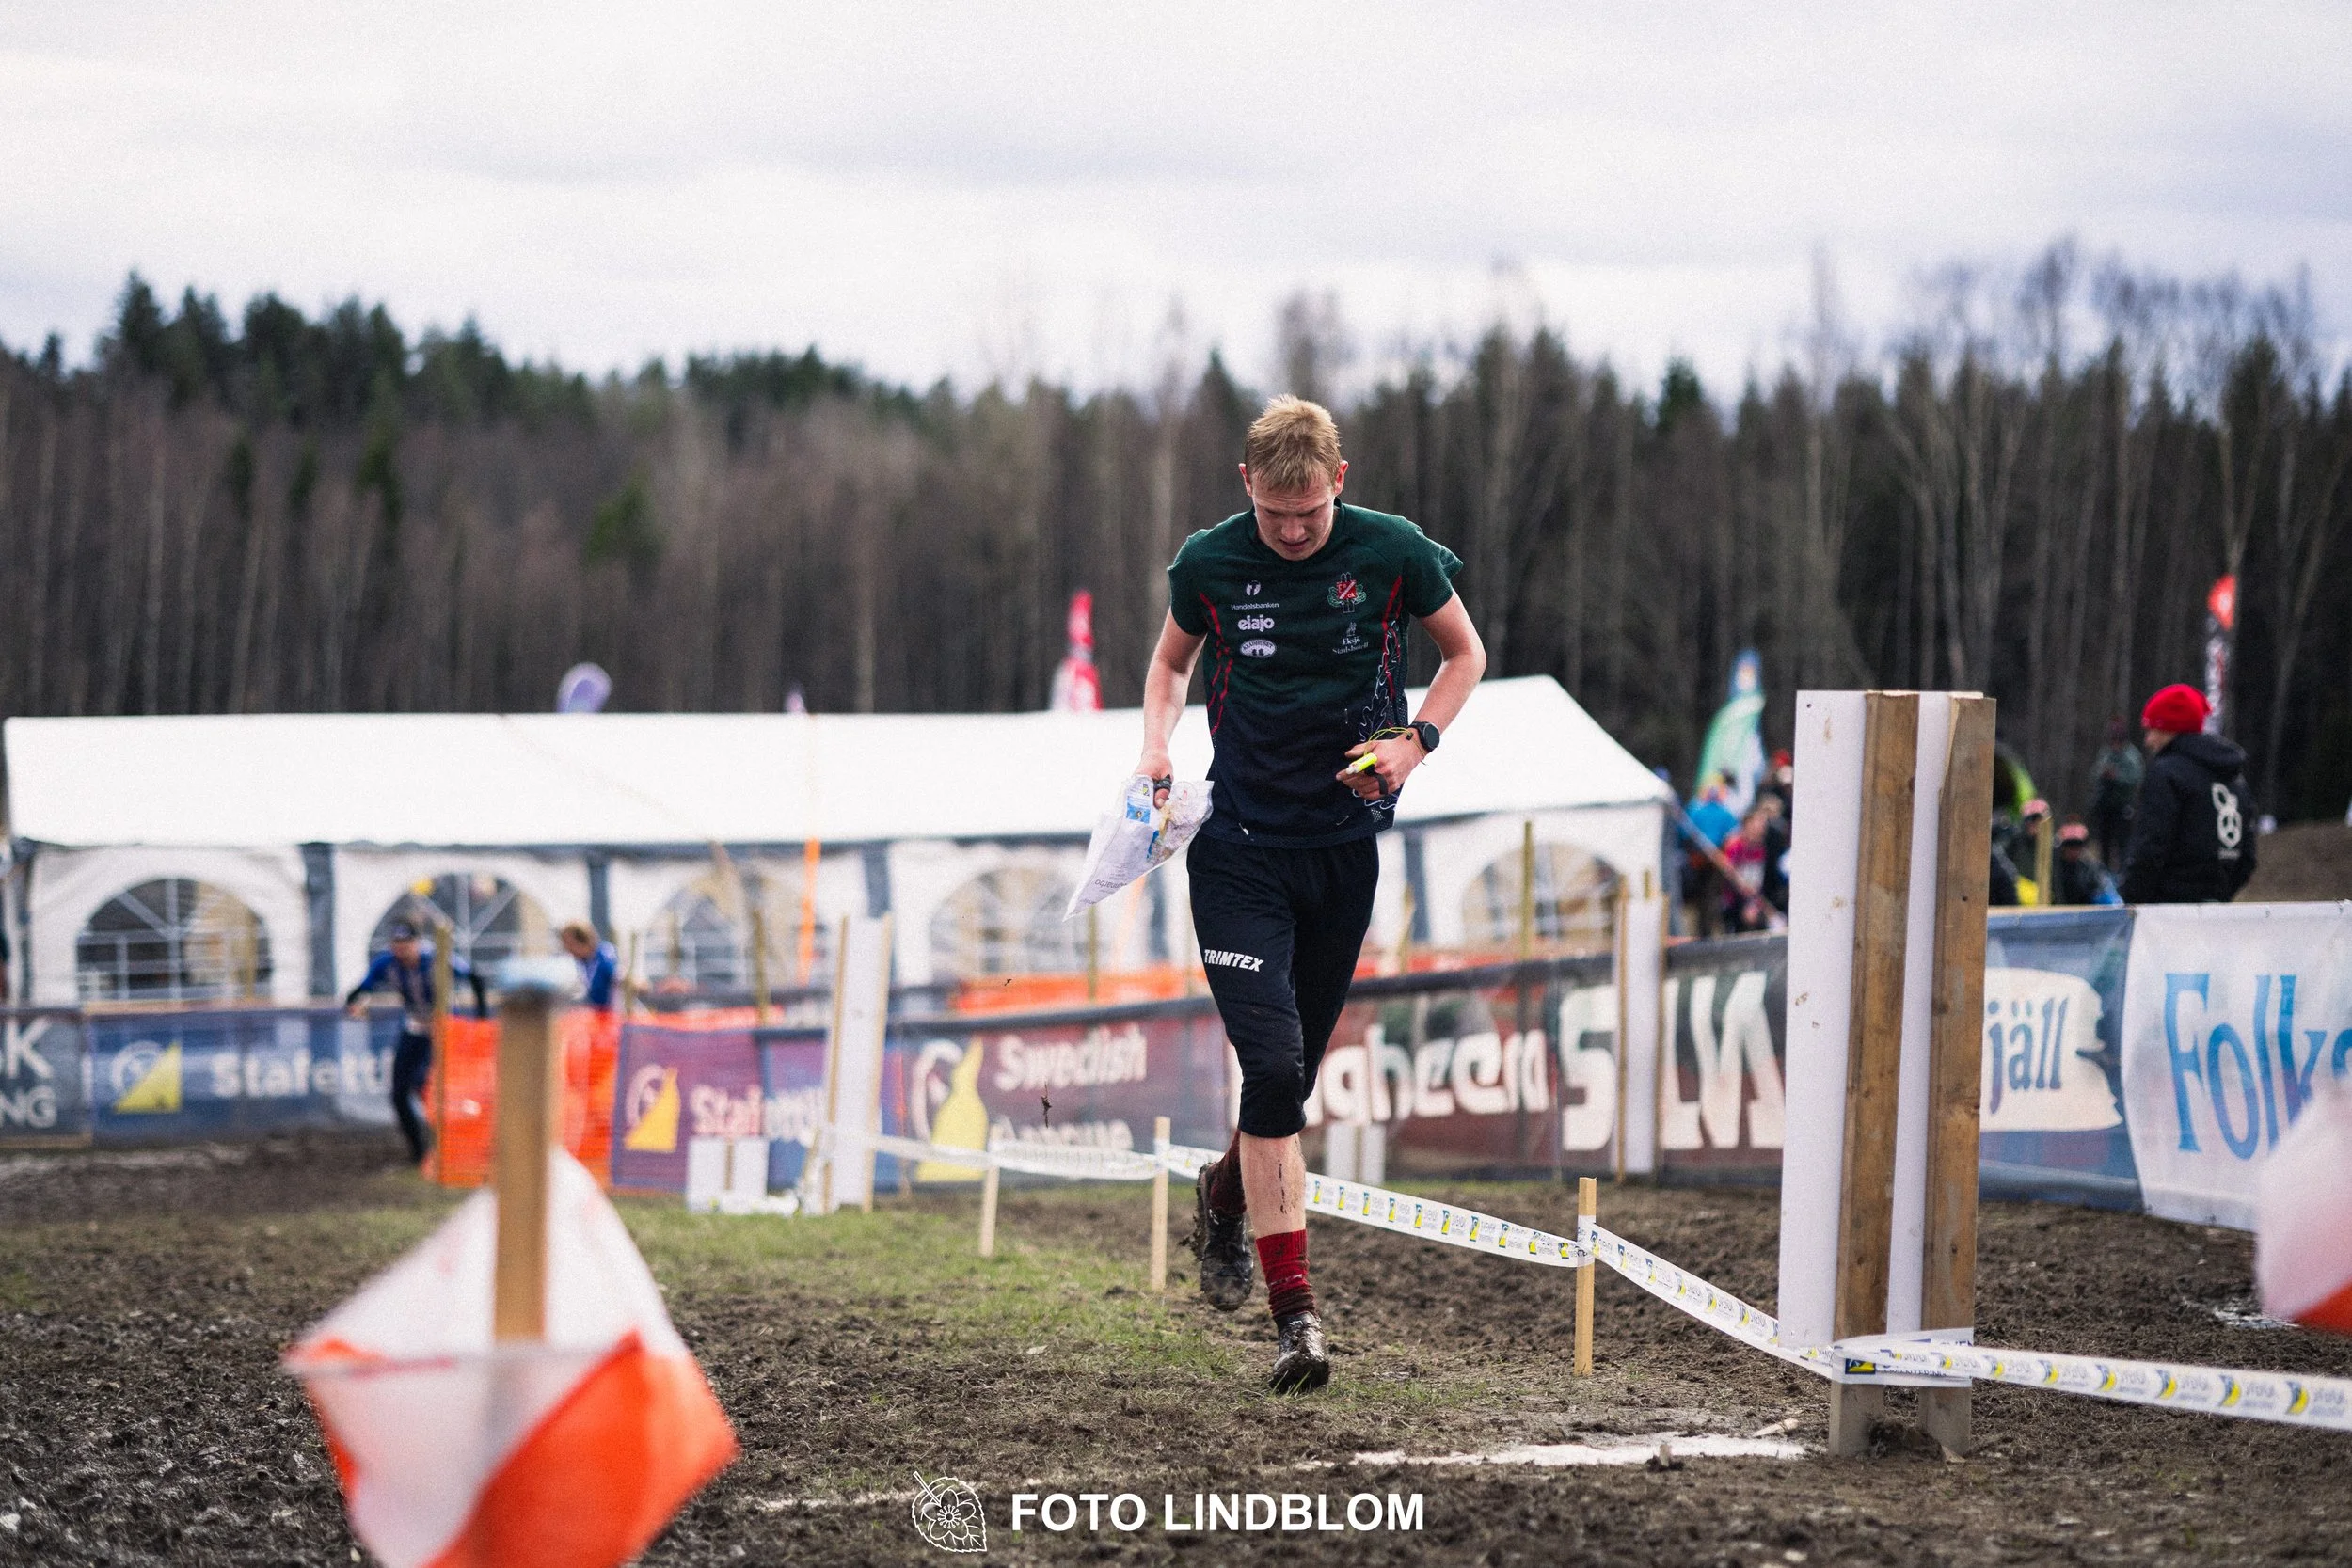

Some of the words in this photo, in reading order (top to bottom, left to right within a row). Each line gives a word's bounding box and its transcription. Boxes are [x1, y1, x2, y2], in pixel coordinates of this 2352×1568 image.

[1231, 602, 1279, 610] Handelsbanken
[1237, 614, 1275, 633] elajo
[1204, 948, 1264, 973] TRIMTEX
[0, 1017, 52, 1078] K
[1559, 971, 1786, 1151] SLVA
[1988, 997, 2069, 1115] jäll
